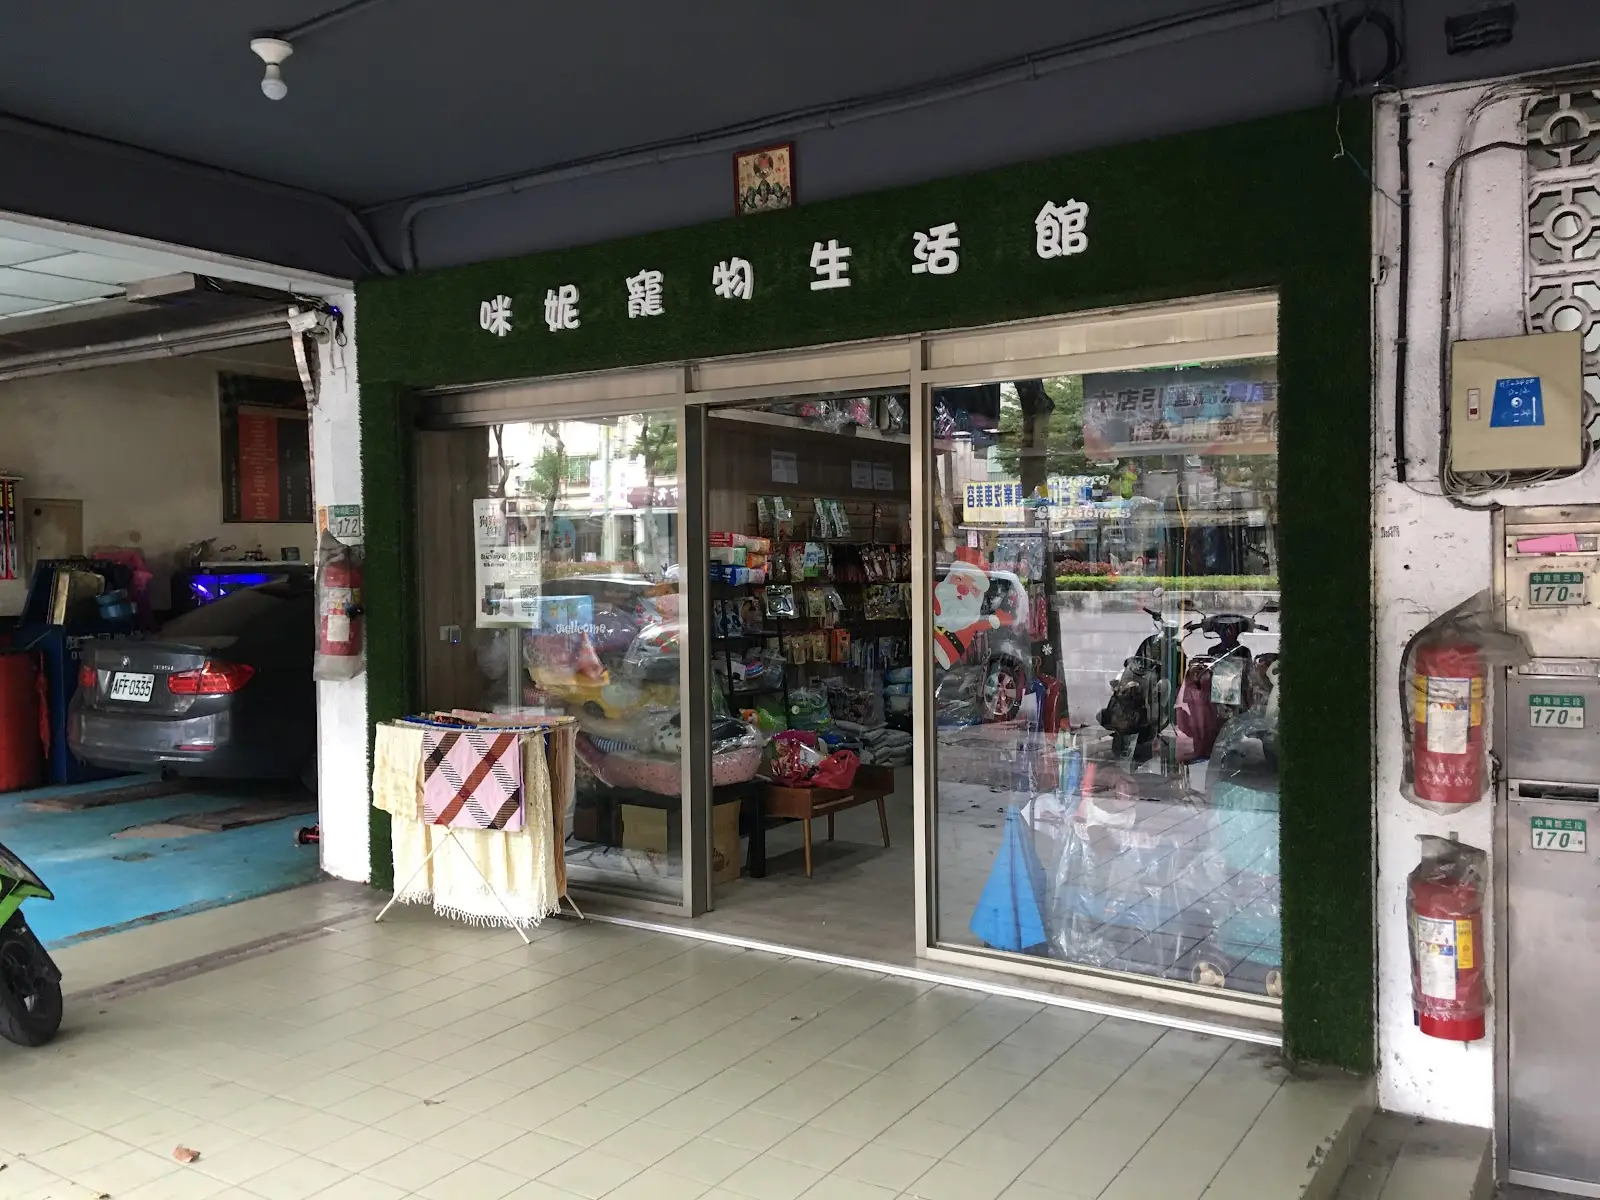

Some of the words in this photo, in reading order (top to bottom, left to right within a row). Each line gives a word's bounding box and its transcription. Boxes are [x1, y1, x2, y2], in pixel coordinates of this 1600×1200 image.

[479, 198, 1090, 337] 咪妮寵物生活館
[338, 518, 358, 533] 172
[1533, 586, 1569, 602] 170
[1533, 709, 1569, 724] 170
[1535, 831, 1570, 848] 170
